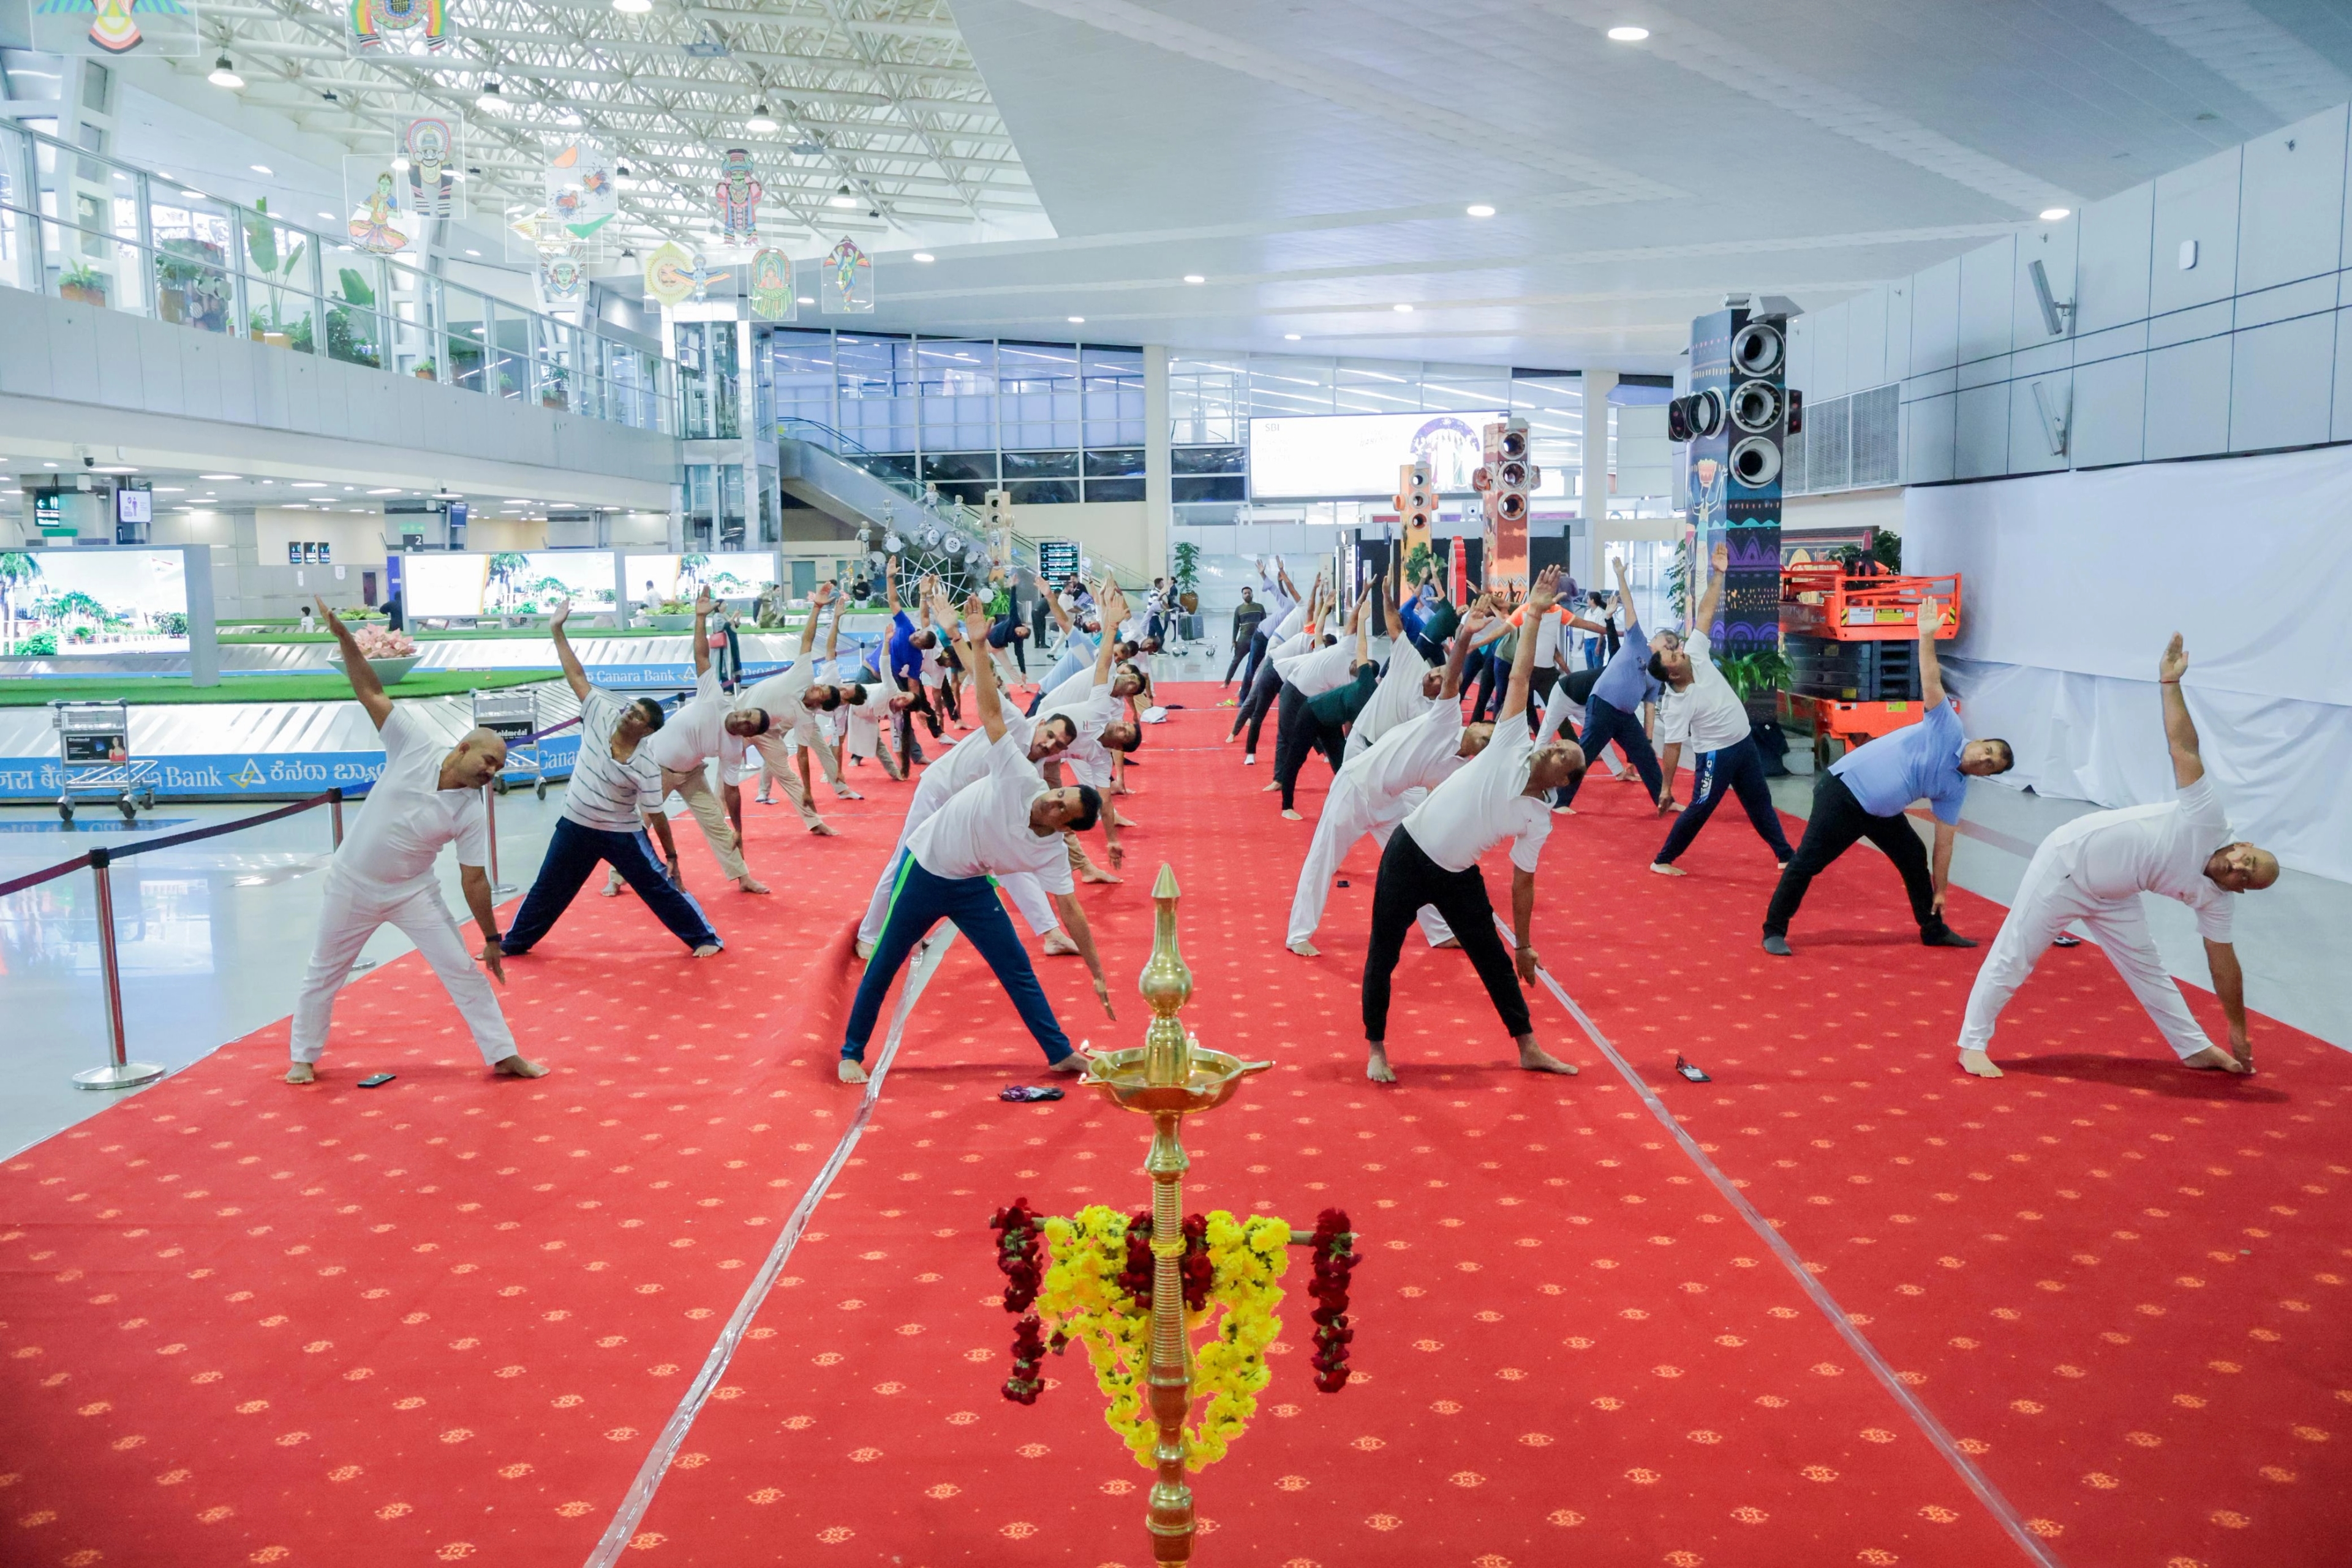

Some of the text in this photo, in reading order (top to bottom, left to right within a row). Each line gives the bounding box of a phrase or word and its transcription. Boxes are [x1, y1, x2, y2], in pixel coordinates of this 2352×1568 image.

[415, 536, 422, 545] 2
[837, 663, 860, 674] Canar
[596, 670, 640, 682] Canara
[644, 669, 676, 682] Bank
[496, 728, 527, 737] oldmedal
[539, 750, 579, 770] Cana
[0, 771, 34, 790] नरा
[165, 766, 224, 788] Bank
